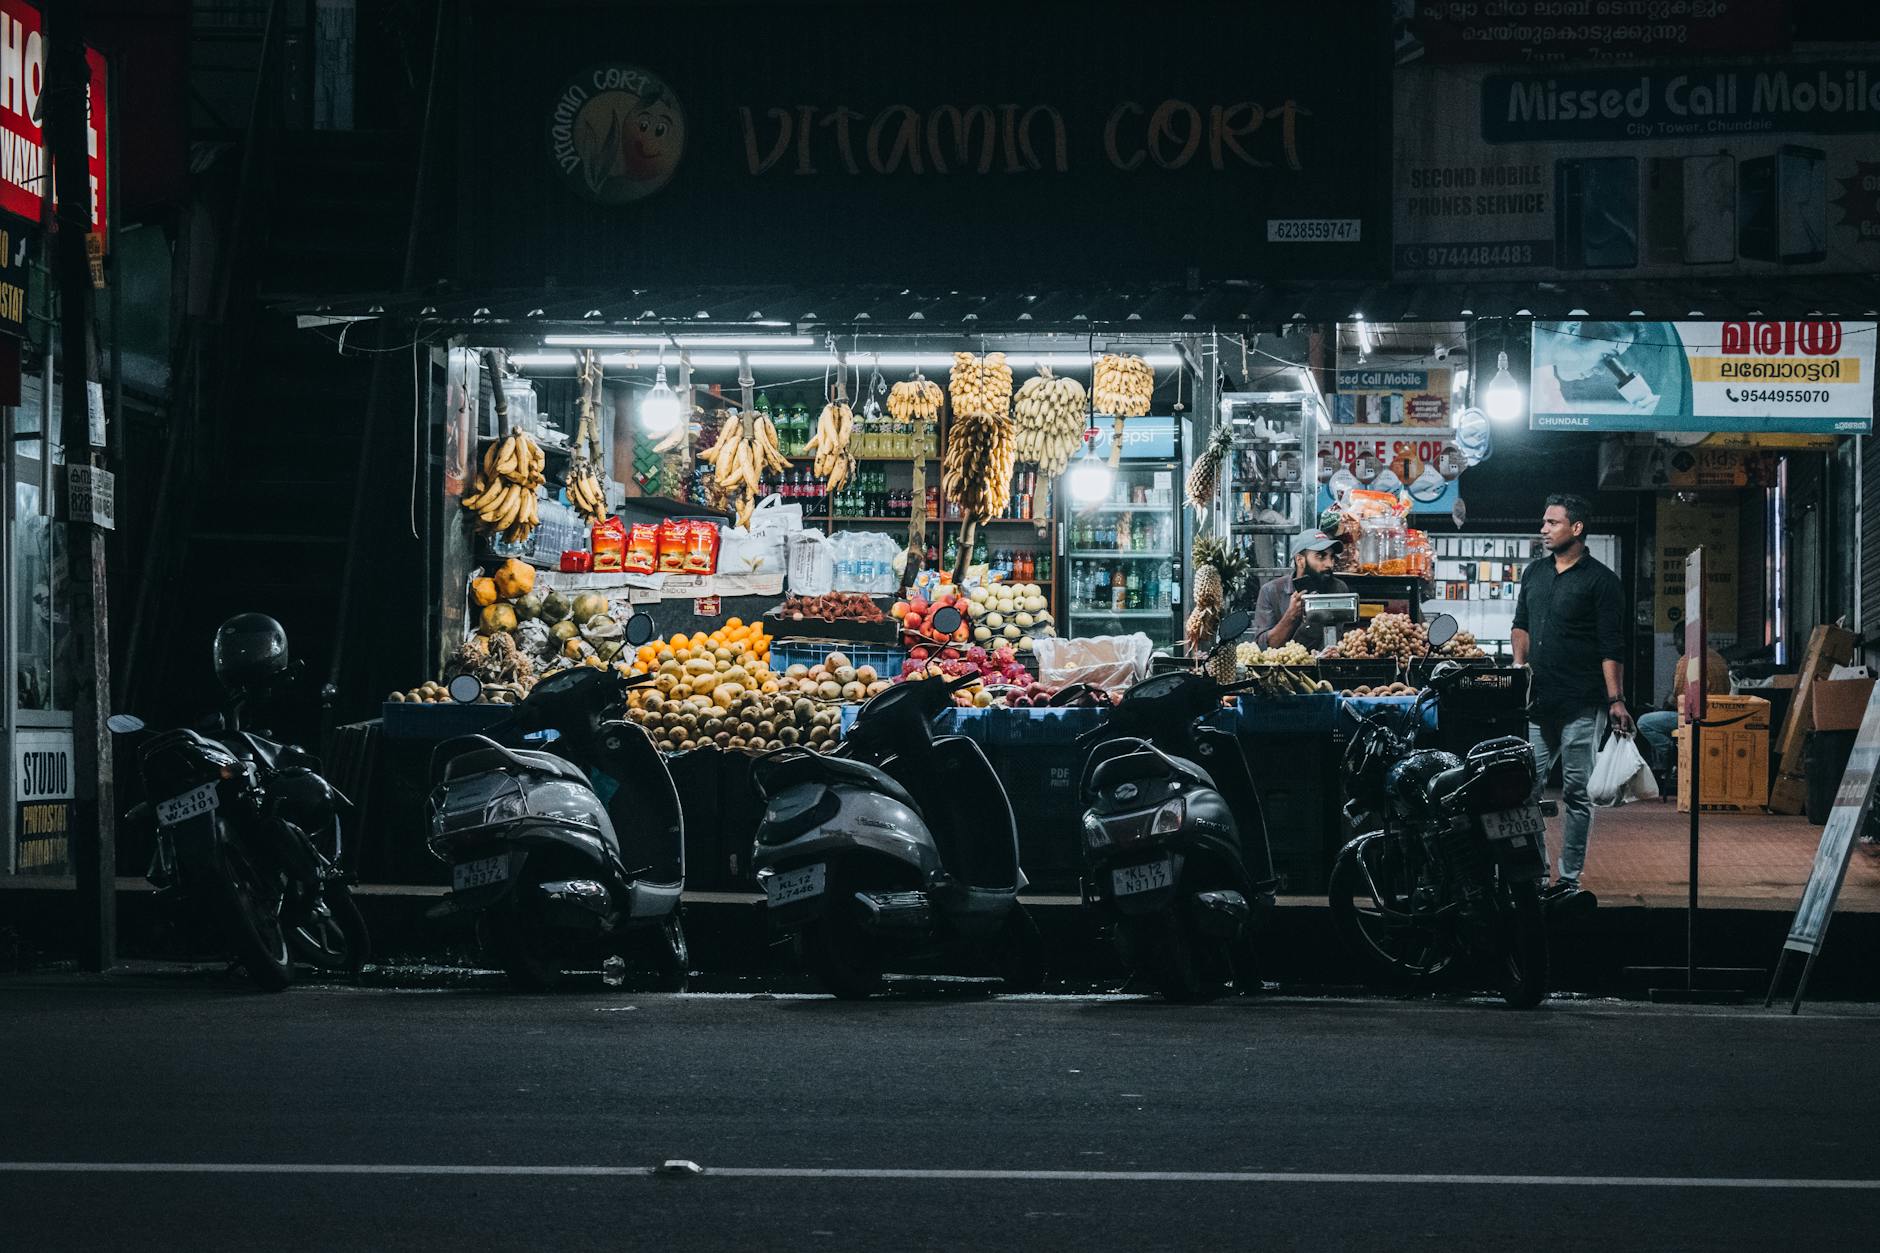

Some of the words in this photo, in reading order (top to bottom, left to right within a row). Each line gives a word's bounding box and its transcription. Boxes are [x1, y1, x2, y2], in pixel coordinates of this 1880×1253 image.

[1507, 76, 1650, 122] Missed
[1665, 73, 1737, 115] Call
[552, 85, 588, 175] VITAMIN
[593, 68, 650, 92] CORT
[1626, 122, 1653, 137] City
[1707, 119, 1773, 132] Chundale
[738, 103, 1069, 175] VITAMIN
[1104, 99, 1313, 172] CORT
[1411, 167, 1476, 188] SECOND
[1480, 165, 1541, 186] MOBILE
[1409, 195, 1472, 216] PHONES
[1476, 193, 1545, 215] SERVICE
[1278, 222, 1353, 238] 6238559747
[1428, 245, 1532, 265] 9744484483
[1339, 373, 1359, 385] sed
[1361, 373, 1381, 385] Call
[1384, 373, 1421, 385] Mobile
[1721, 360, 1840, 381] ലബോറട്ടറി
[1741, 390, 1829, 402] 9544955070
[1538, 417, 1589, 425] CHUNDALE
[24, 751, 67, 795] STUDIO
